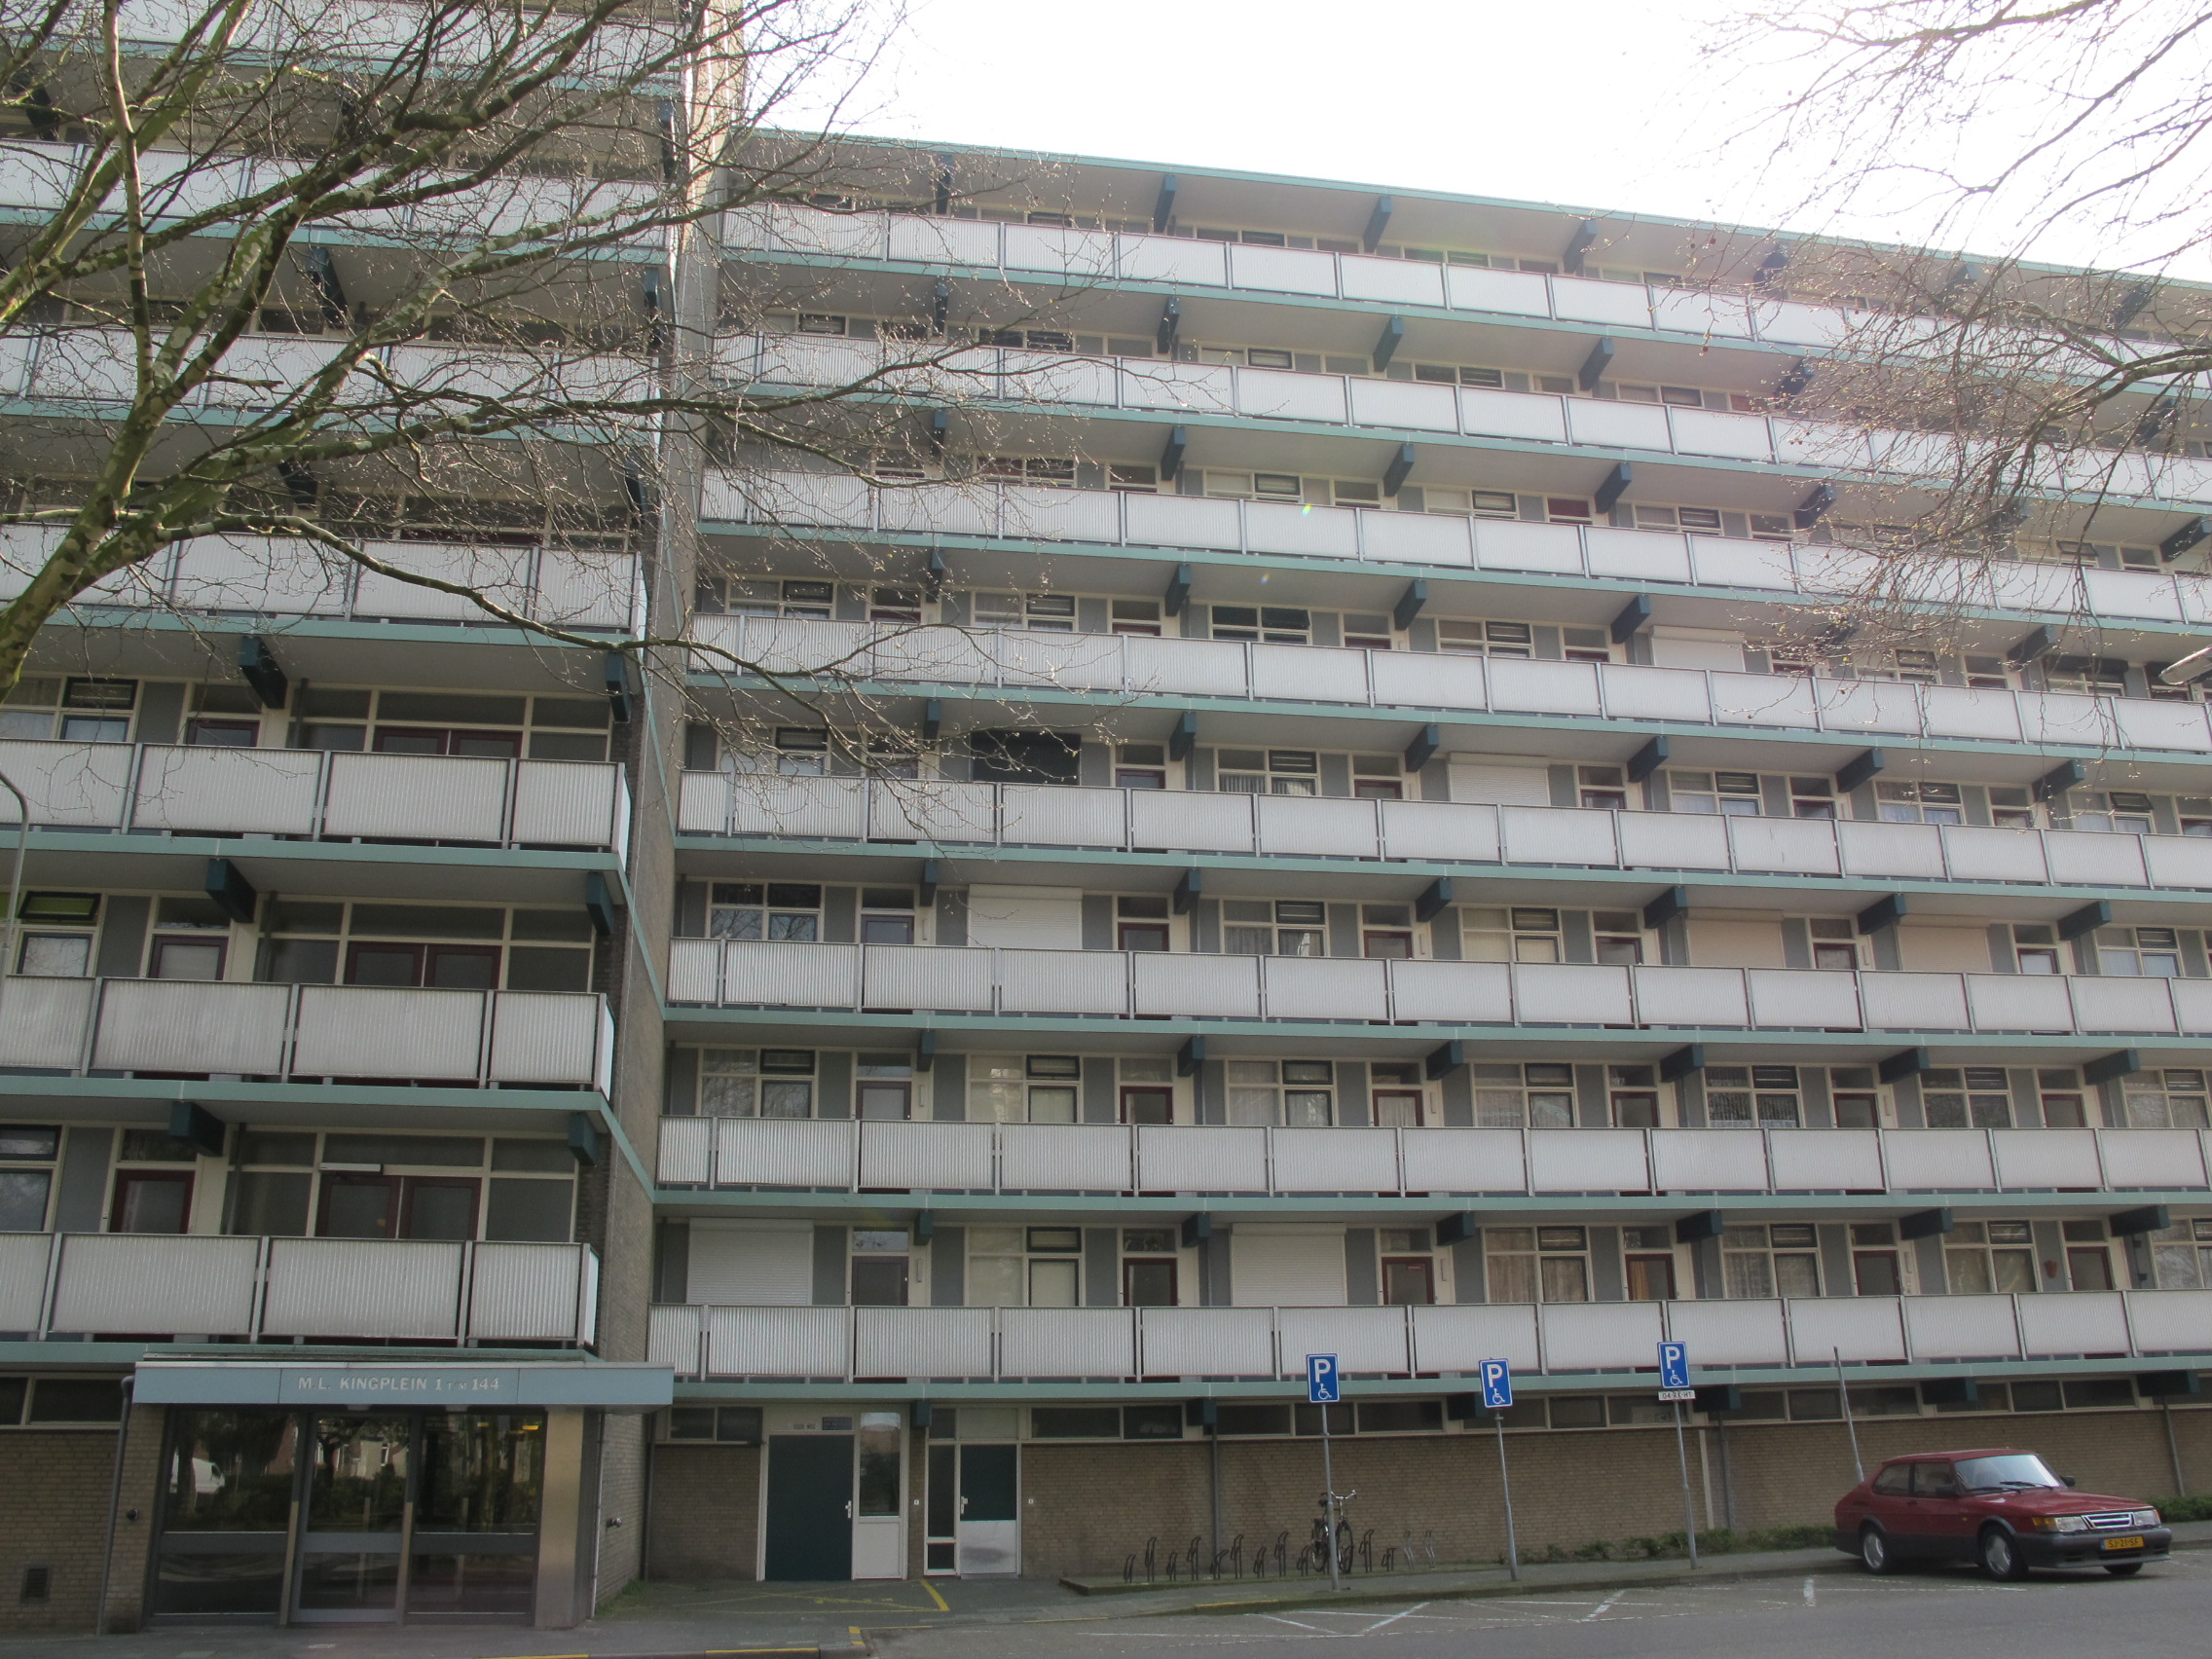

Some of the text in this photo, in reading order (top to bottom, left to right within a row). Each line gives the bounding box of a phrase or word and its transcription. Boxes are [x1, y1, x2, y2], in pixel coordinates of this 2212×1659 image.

[1314, 1358, 1331, 1382] P
[1665, 1346, 1680, 1370] P
[298, 1377, 331, 1390] M.L.
[341, 1377, 427, 1390] KINGPLEIN
[435, 1378, 443, 1390] 1
[471, 1377, 499, 1390] 144
[1487, 1363, 1503, 1388] P
[2108, 1537, 2139, 1548] SJ-21-SF
